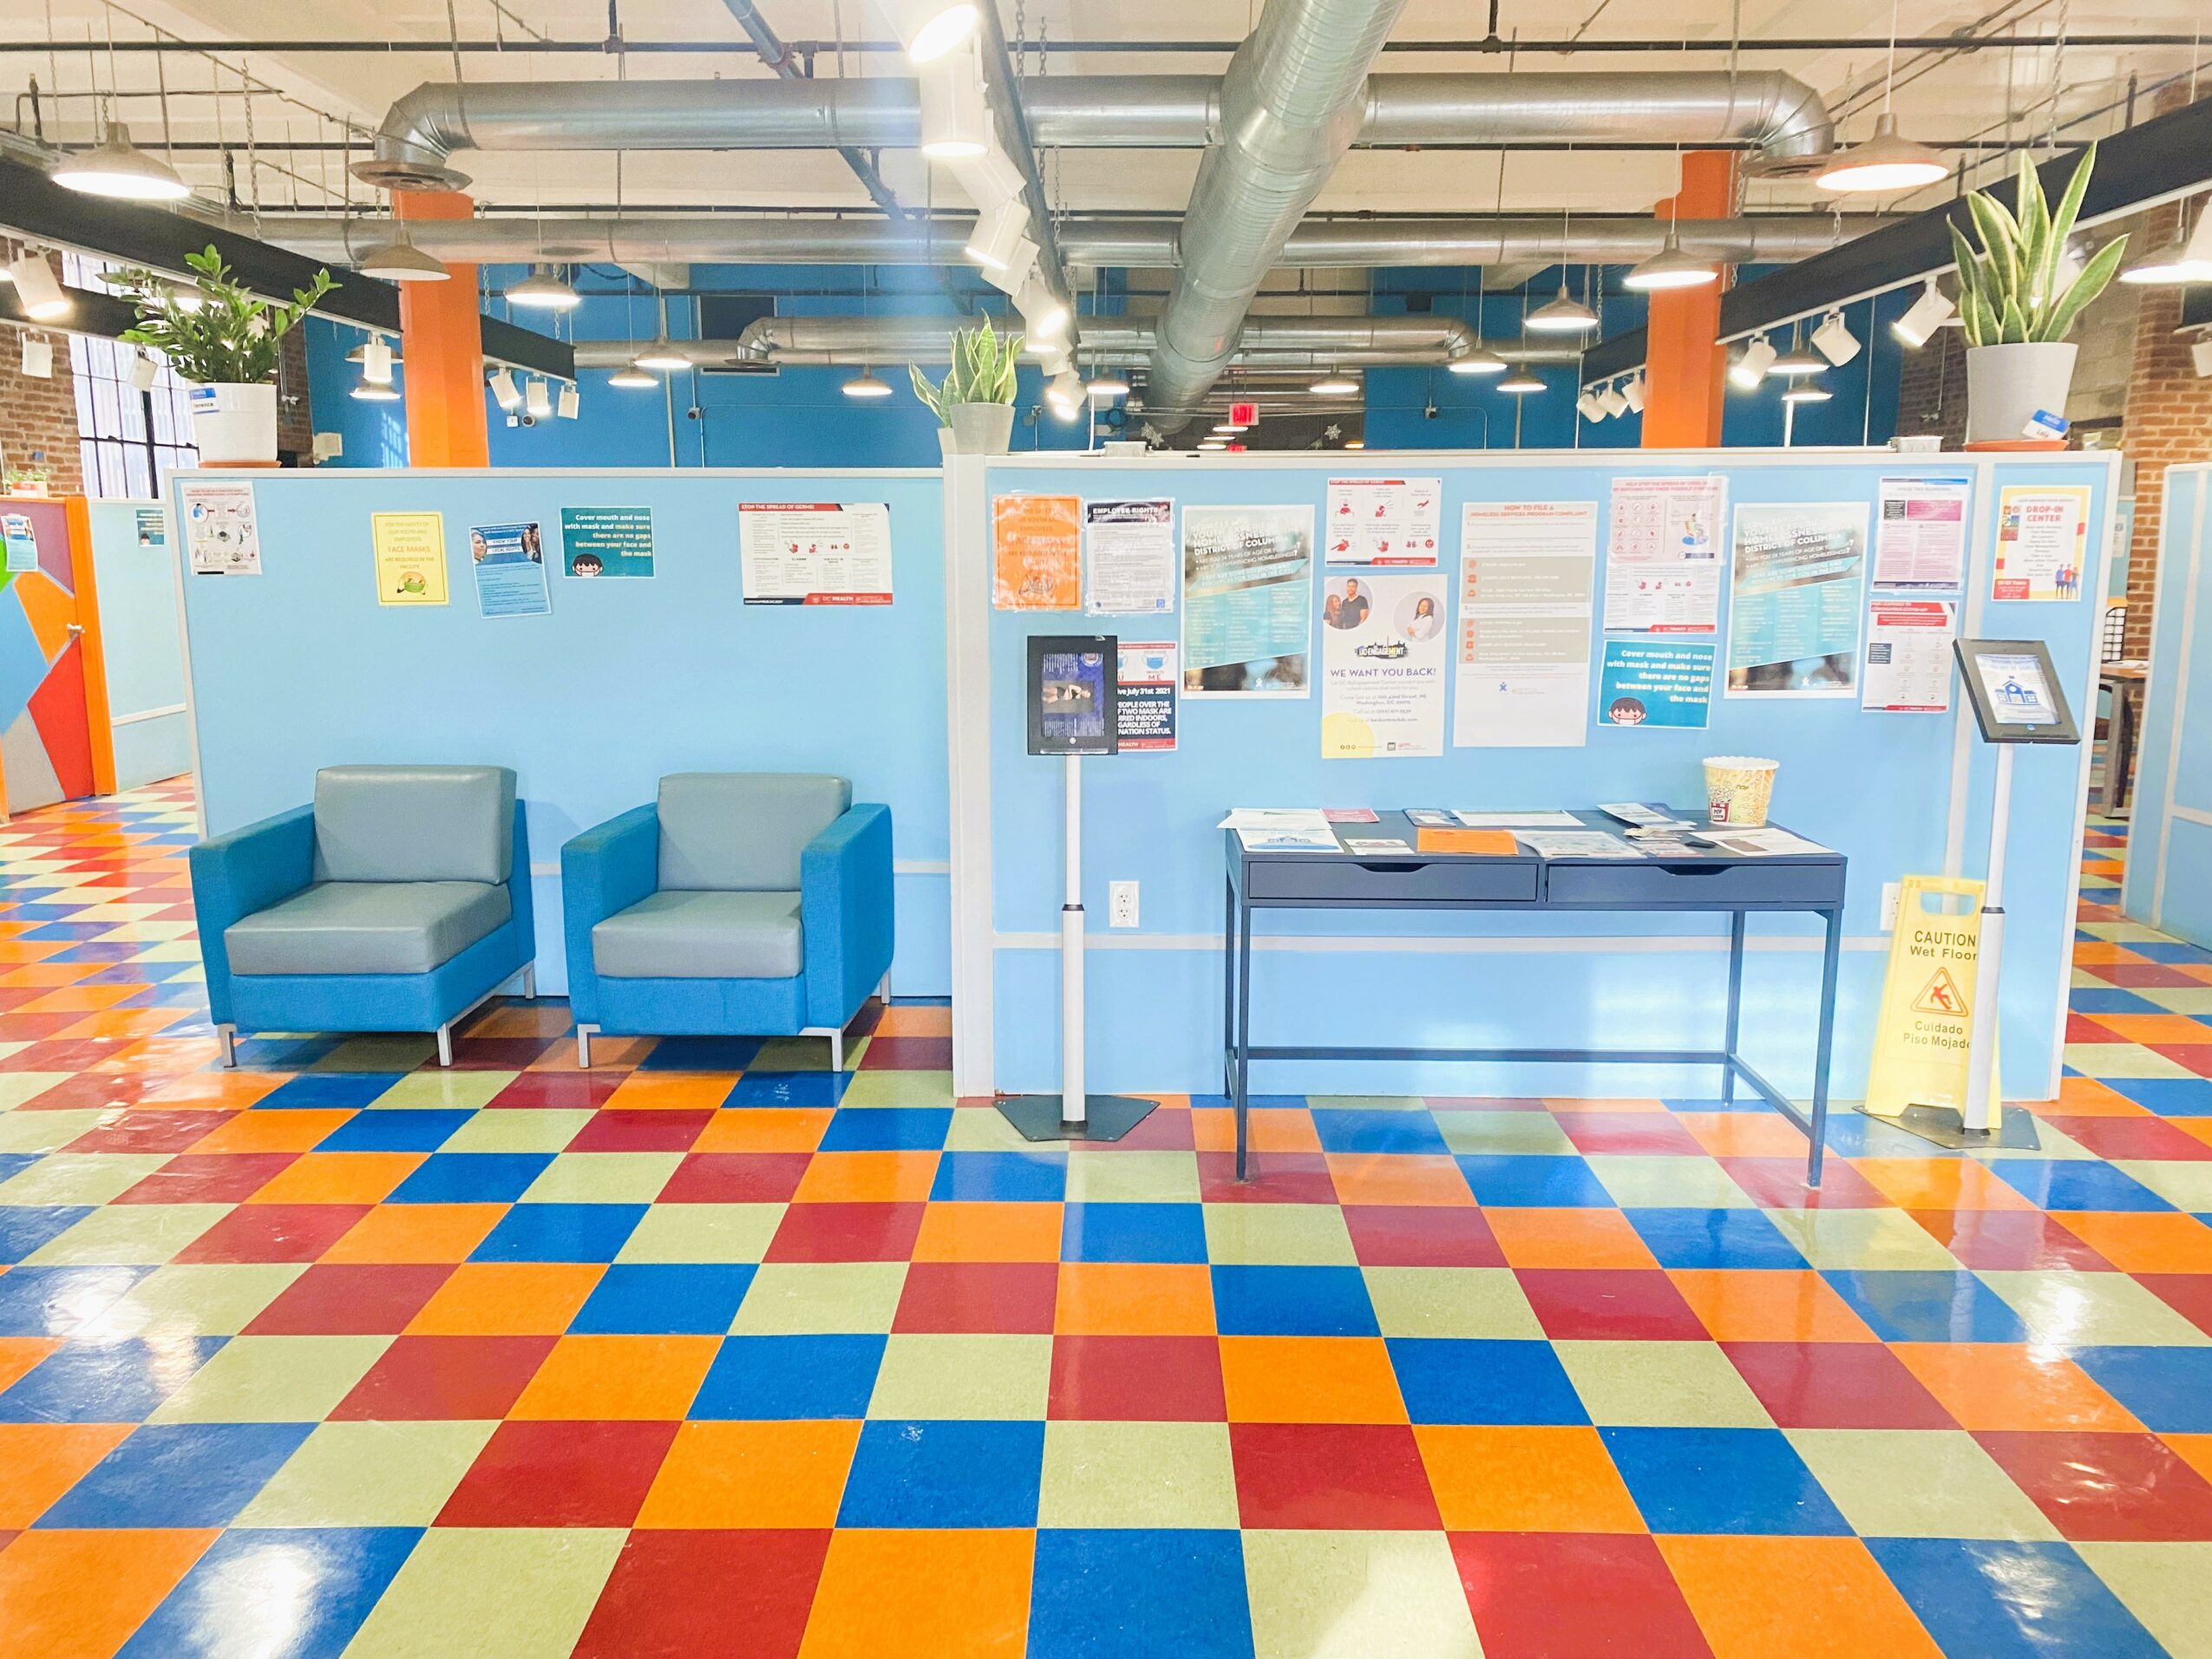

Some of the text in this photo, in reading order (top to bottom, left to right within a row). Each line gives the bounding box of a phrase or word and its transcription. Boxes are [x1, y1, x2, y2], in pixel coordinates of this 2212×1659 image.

[1194, 544, 1232, 556] DISTRICT
[1233, 542, 1244, 551] OF
[1744, 542, 1783, 553] DISTRICT
[1620, 650, 1646, 658] Cover
[1646, 650, 1674, 659] mouth
[1406, 668, 1436, 676] BACK!
[1638, 671, 1661, 680] there
[1690, 674, 1711, 683] gaps
[1127, 687, 1140, 696] July
[1615, 682, 1709, 693] between your face and
[1914, 930, 1977, 948] CAUTION
[1910, 945, 1978, 961] Wet Floor
[1914, 1021, 1963, 1035] Cuidado
[1903, 1033, 1928, 1045] Piso
